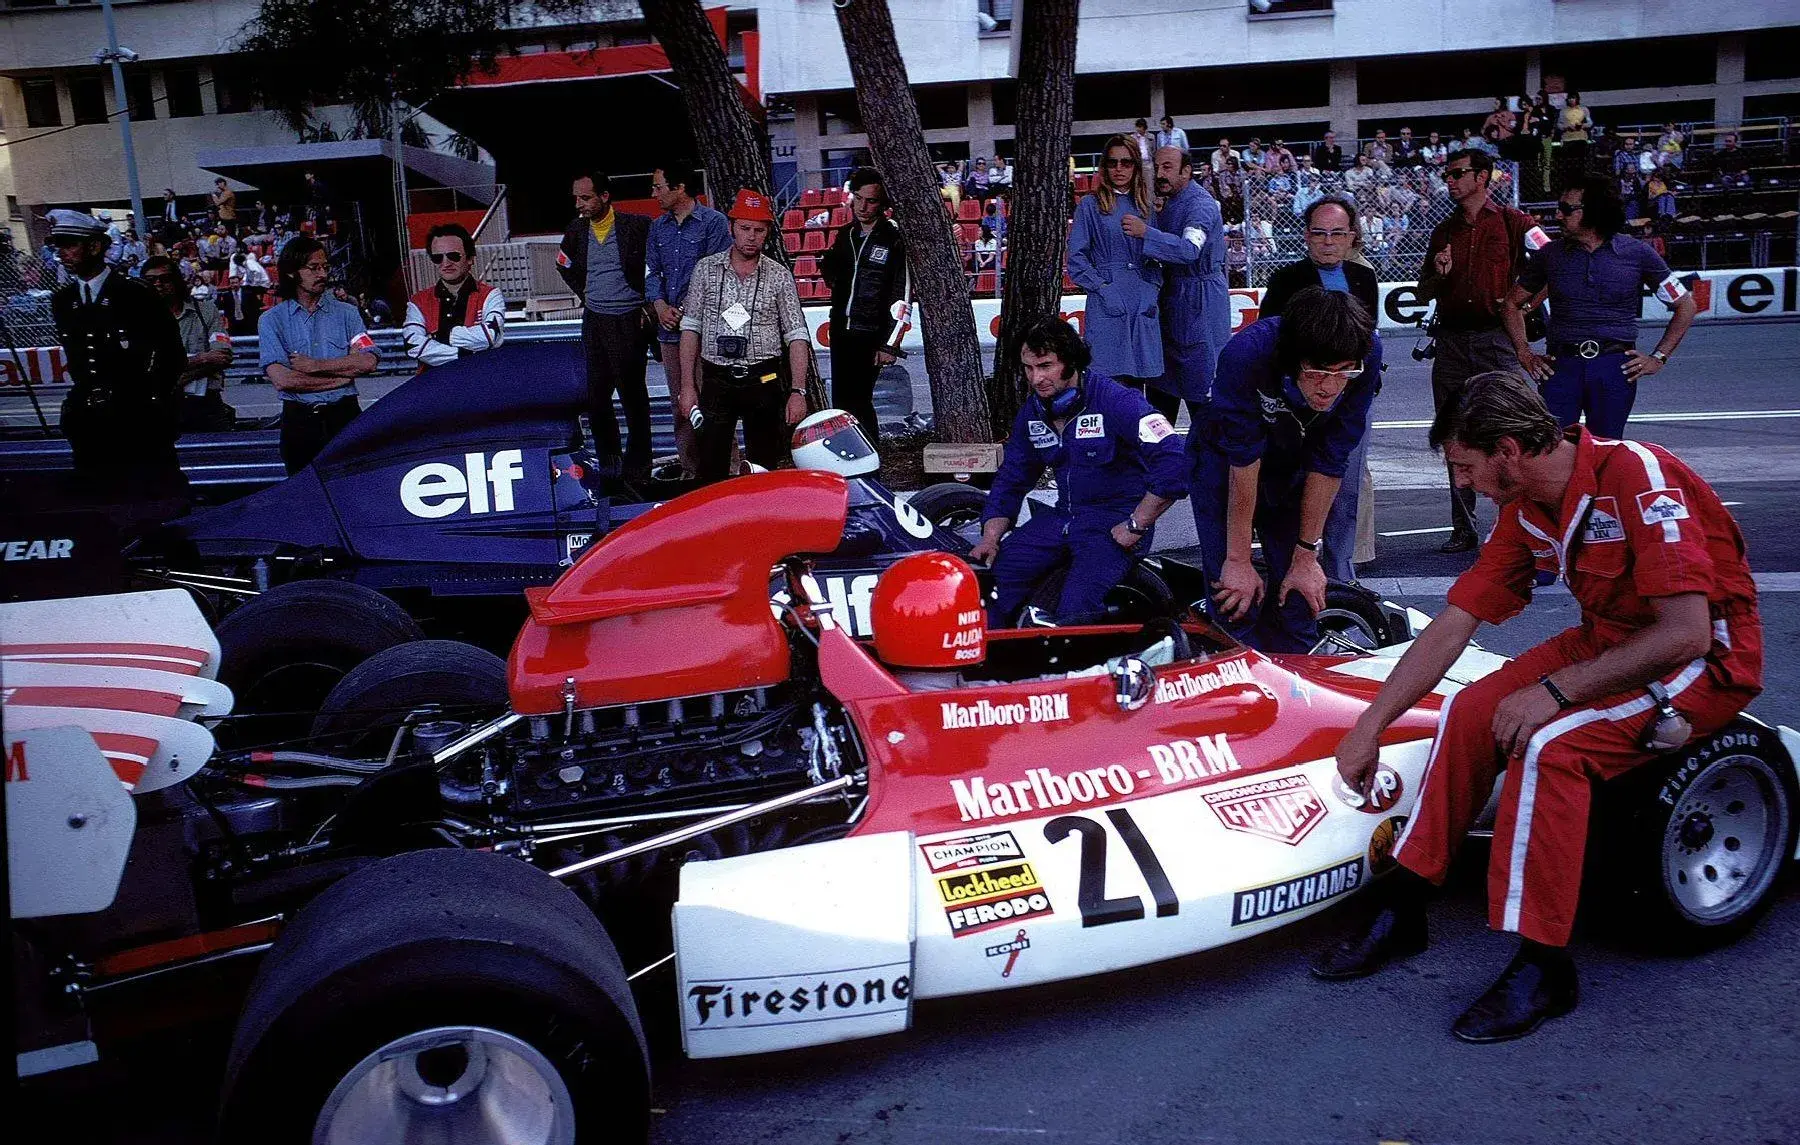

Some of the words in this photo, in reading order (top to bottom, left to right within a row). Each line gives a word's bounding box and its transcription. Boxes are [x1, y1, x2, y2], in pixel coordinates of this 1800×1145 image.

[1080, 416, 1098, 428] elf
[400, 449, 524, 519] elf
[894, 497, 933, 539] 6
[941, 693, 1070, 730] Marlboro-BRM
[1203, 775, 1310, 804] CHRONOGRAPH
[1222, 790, 1318, 838] HEUER
[933, 841, 1011, 860] CHAMPION
[1043, 808, 1179, 928] 21
[940, 864, 1033, 901] Lockheed
[1239, 862, 1358, 922] DUCKHAMS
[949, 894, 1049, 930] FERODO
[987, 940, 1028, 956] KONI
[688, 974, 911, 1026] Firestone
